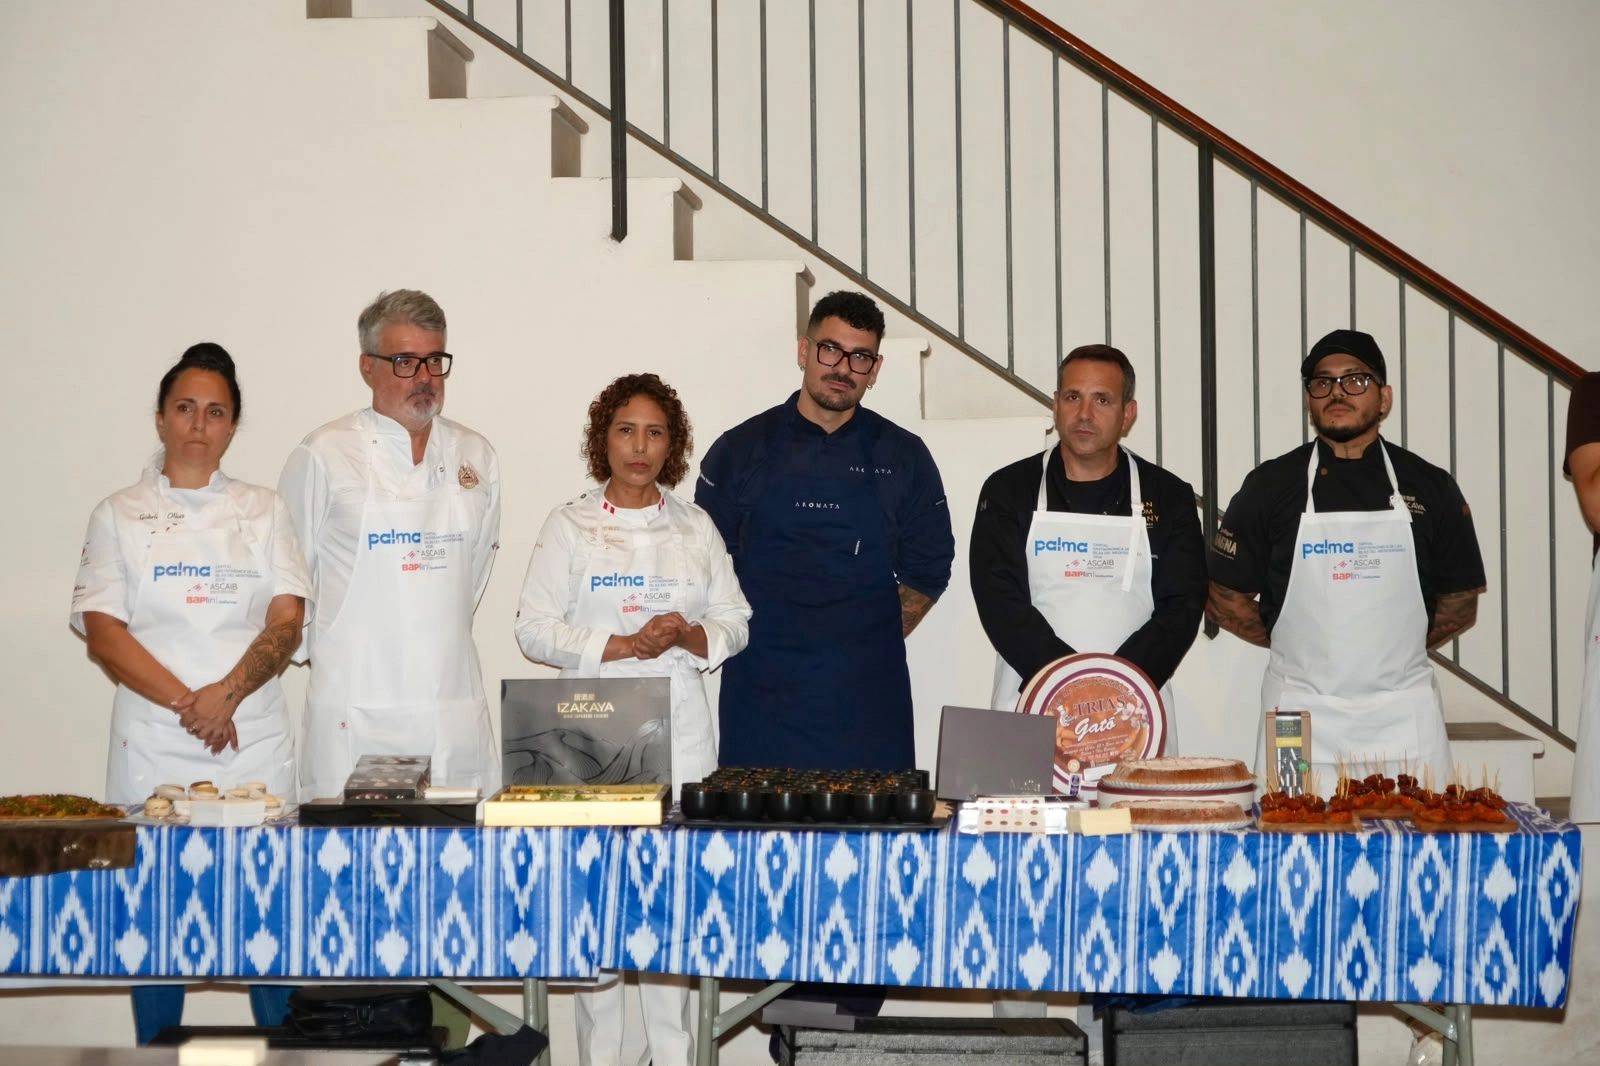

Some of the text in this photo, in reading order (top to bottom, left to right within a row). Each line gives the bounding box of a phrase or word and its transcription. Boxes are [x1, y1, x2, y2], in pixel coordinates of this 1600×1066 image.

[849, 466, 892, 474] AROATA
[795, 501, 840, 510] AROMATA
[421, 549, 446, 557] ASCAIB
[1354, 559, 1381, 567] ASCAIB
[210, 583, 238, 591] ASCAIB
[644, 592, 671, 600] ASCAIB
[557, 701, 615, 713] IZAKAYA
[1073, 695, 1127, 716] TRIAS
